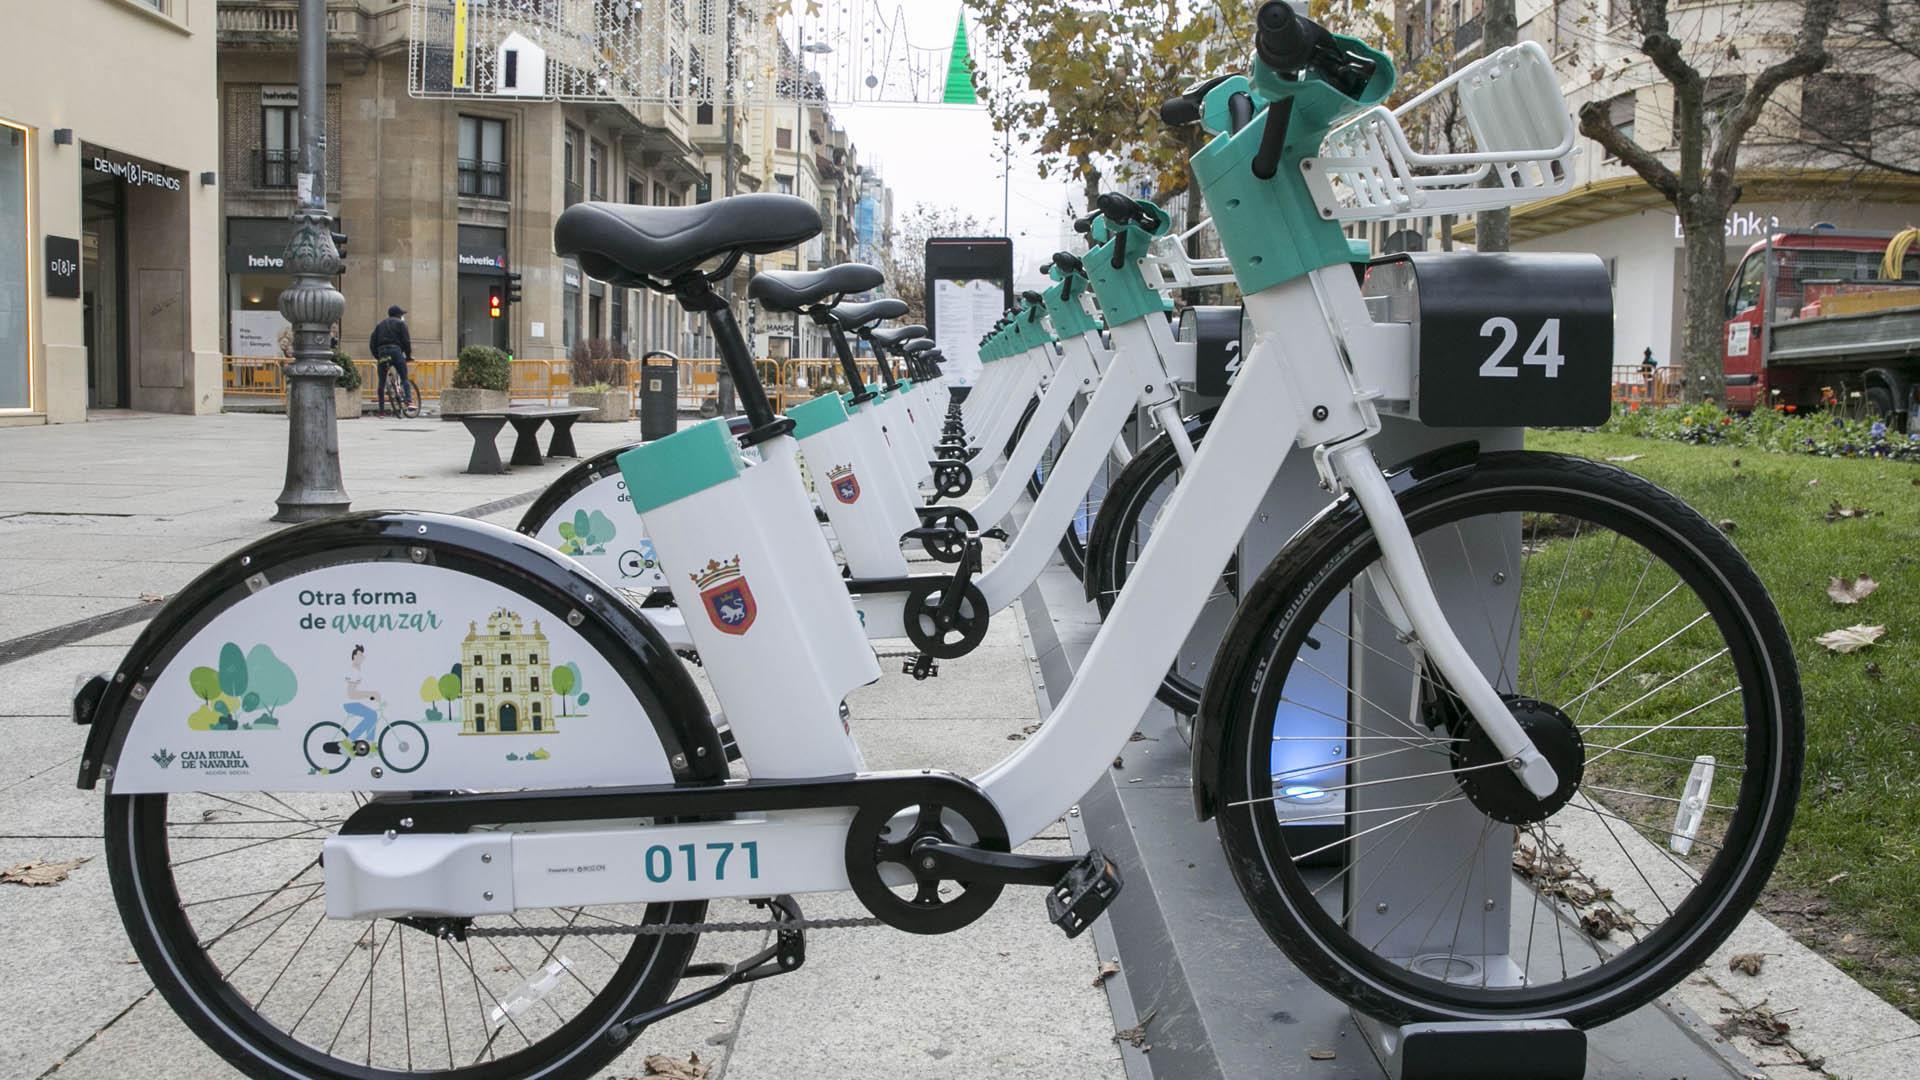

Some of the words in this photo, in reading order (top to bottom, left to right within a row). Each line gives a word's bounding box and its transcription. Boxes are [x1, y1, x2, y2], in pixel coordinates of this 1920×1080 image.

[248, 255, 284, 267] helve
[459, 254, 495, 266] helvetia
[1479, 316, 1565, 379] 24
[298, 590, 346, 606] Otra
[352, 588, 417, 605] forma
[300, 613, 327, 629] de
[331, 610, 443, 634] avanzar
[1251, 657, 1267, 694] CST
[181, 751, 206, 760] CAJA
[208, 750, 244, 760] RURAL
[182, 760, 196, 769] DE
[199, 760, 249, 769] NAVARRA
[645, 841, 759, 883] 0171
